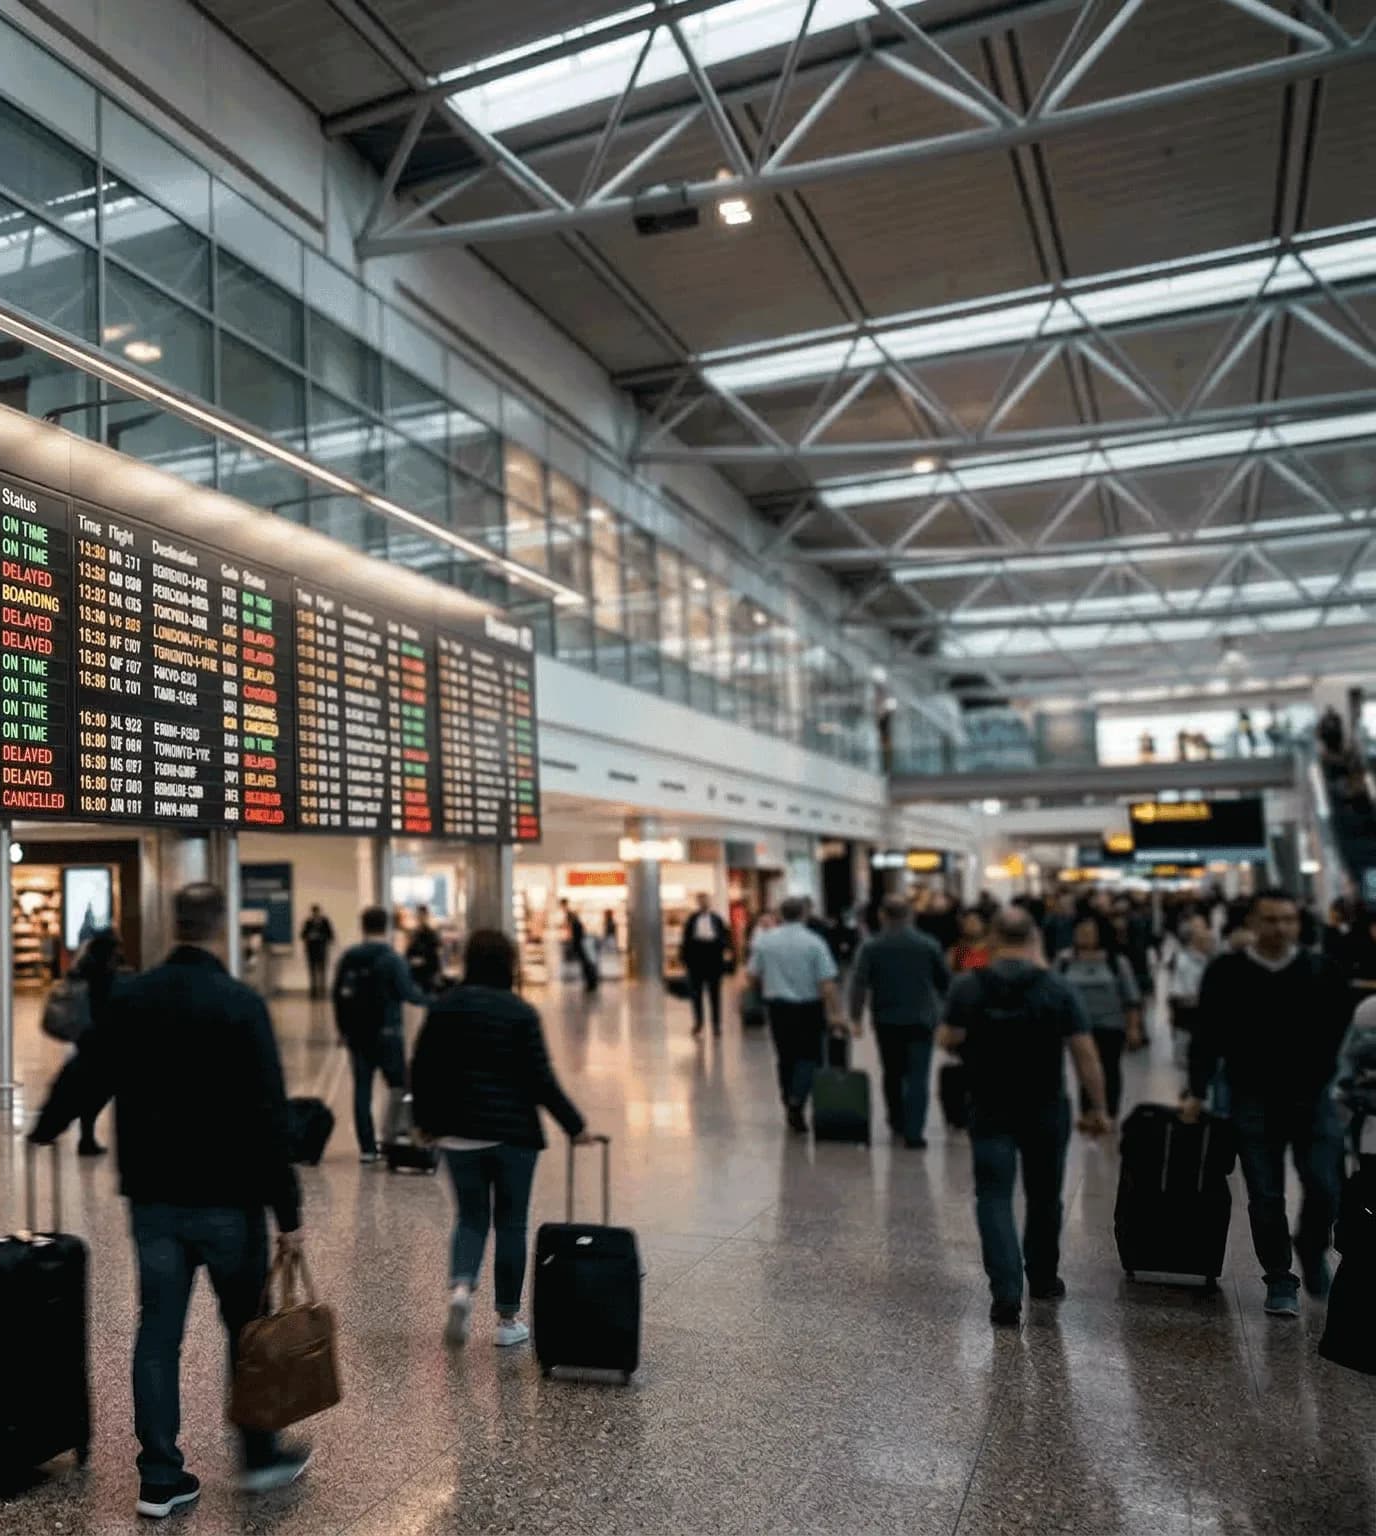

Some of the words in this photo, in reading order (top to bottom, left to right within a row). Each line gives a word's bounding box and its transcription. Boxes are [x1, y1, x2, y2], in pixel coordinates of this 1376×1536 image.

[1, 487, 37, 514] Status
[2, 515, 19, 535] ON
[21, 520, 49, 544] TIME
[2, 537, 19, 557] ON
[21, 542, 49, 566] TIME
[2, 560, 53, 588] DELAYED
[2, 583, 60, 613] BOARDING
[2, 606, 53, 633] DELAYED
[2, 630, 53, 655] DELAYED
[2, 653, 19, 671] ON
[21, 656, 49, 677] TIME
[2, 675, 19, 694] ON
[21, 679, 48, 699] TIME
[2, 698, 19, 716] ON
[21, 701, 48, 721] TIME
[2, 721, 19, 739] ON
[21, 723, 48, 742] TIME
[2, 744, 53, 765] DELAYED
[2, 767, 53, 787] DELAYED
[2, 789, 65, 809] CANCELLED
